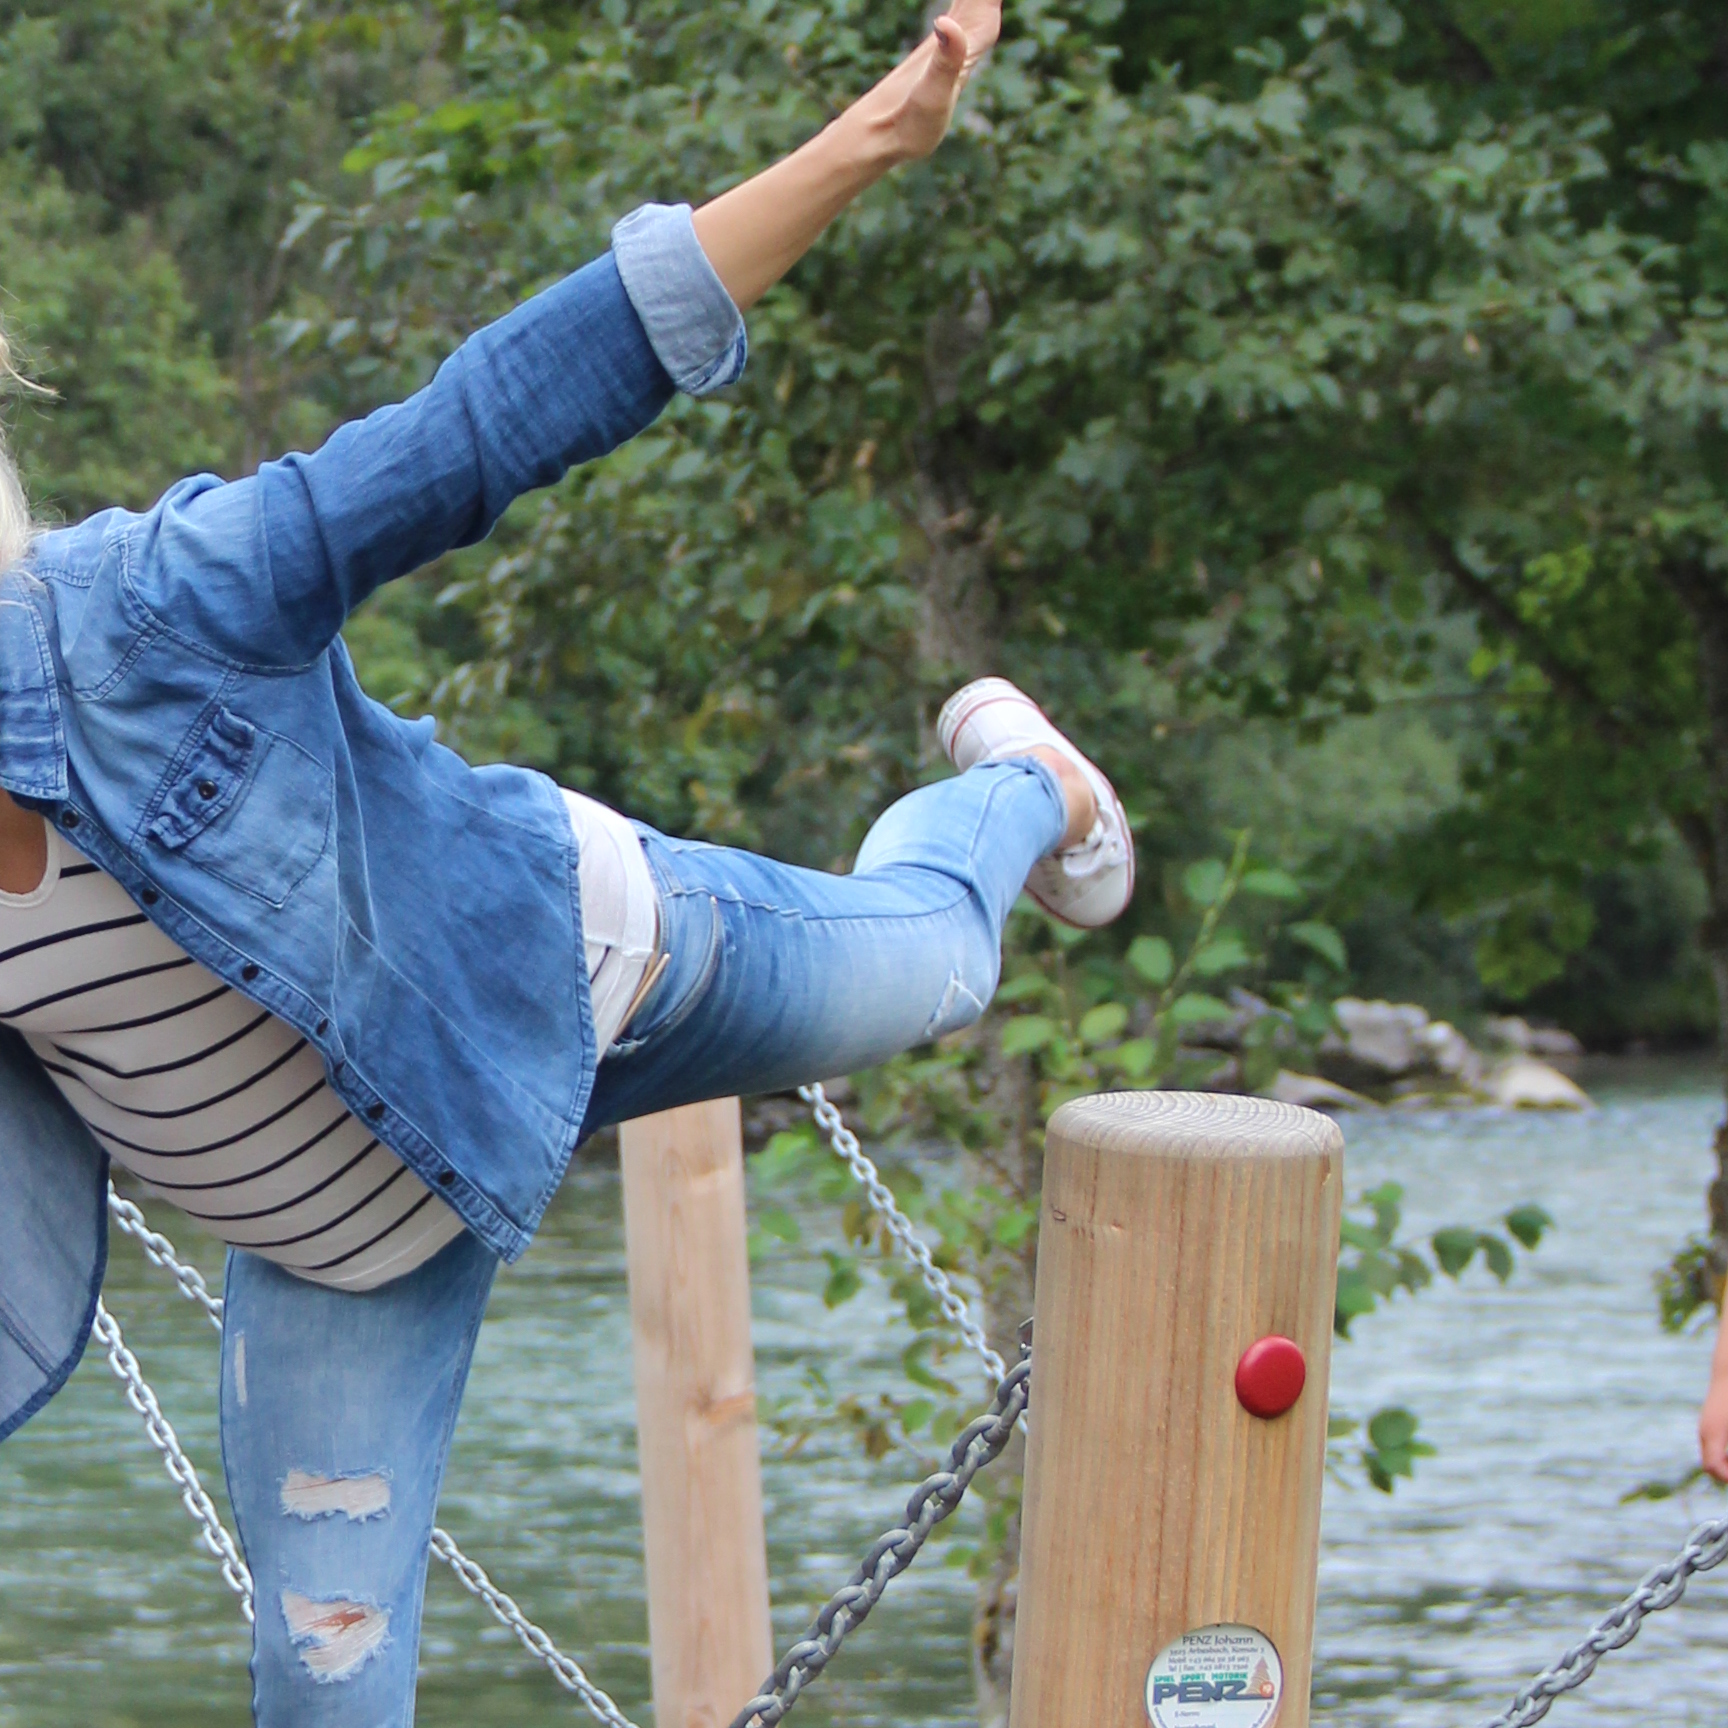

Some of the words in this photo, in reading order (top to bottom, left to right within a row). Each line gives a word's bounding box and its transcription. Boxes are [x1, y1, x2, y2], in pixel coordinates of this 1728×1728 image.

[1182, 1635, 1211, 1646] PENZ
[1214, 1635, 1253, 1646] Johann
[1154, 1675, 1175, 1683] SPIEL
[1180, 1673, 1206, 1681] SPORT
[1211, 1672, 1248, 1680] MOTORIK
[1153, 1680, 1274, 1705] PENZ
